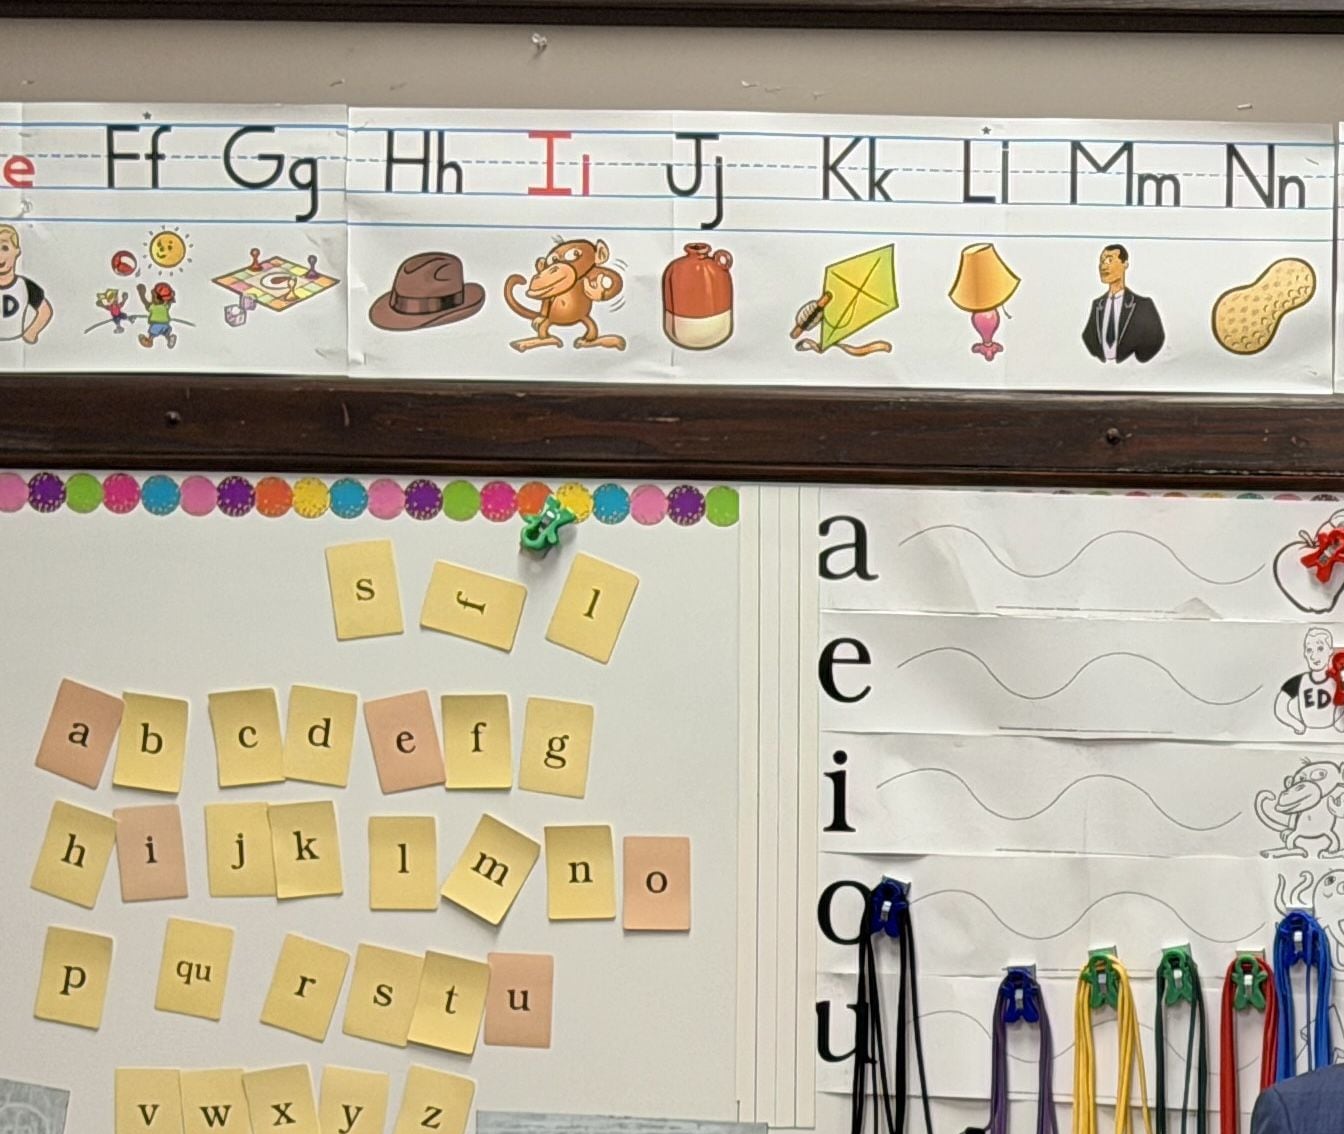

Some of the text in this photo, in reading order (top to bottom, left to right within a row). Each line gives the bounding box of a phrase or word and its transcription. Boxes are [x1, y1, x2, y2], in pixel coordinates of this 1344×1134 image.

[107, 125, 170, 188] Ff
[224, 126, 317, 222] Gg
[386, 130, 462, 193] Hh
[529, 132, 589, 195] Ii
[668, 133, 722, 230] Jj
[824, 137, 889, 200] Kk
[1071, 141, 1179, 204] Mm
[1227, 144, 1304, 207] Nn
[819, 516, 877, 580] a
[819, 638, 870, 702] e
[69, 719, 568, 767] a b c d e f g
[824, 751, 855, 832] i
[139, 1103, 441, 1134] v w x y z
